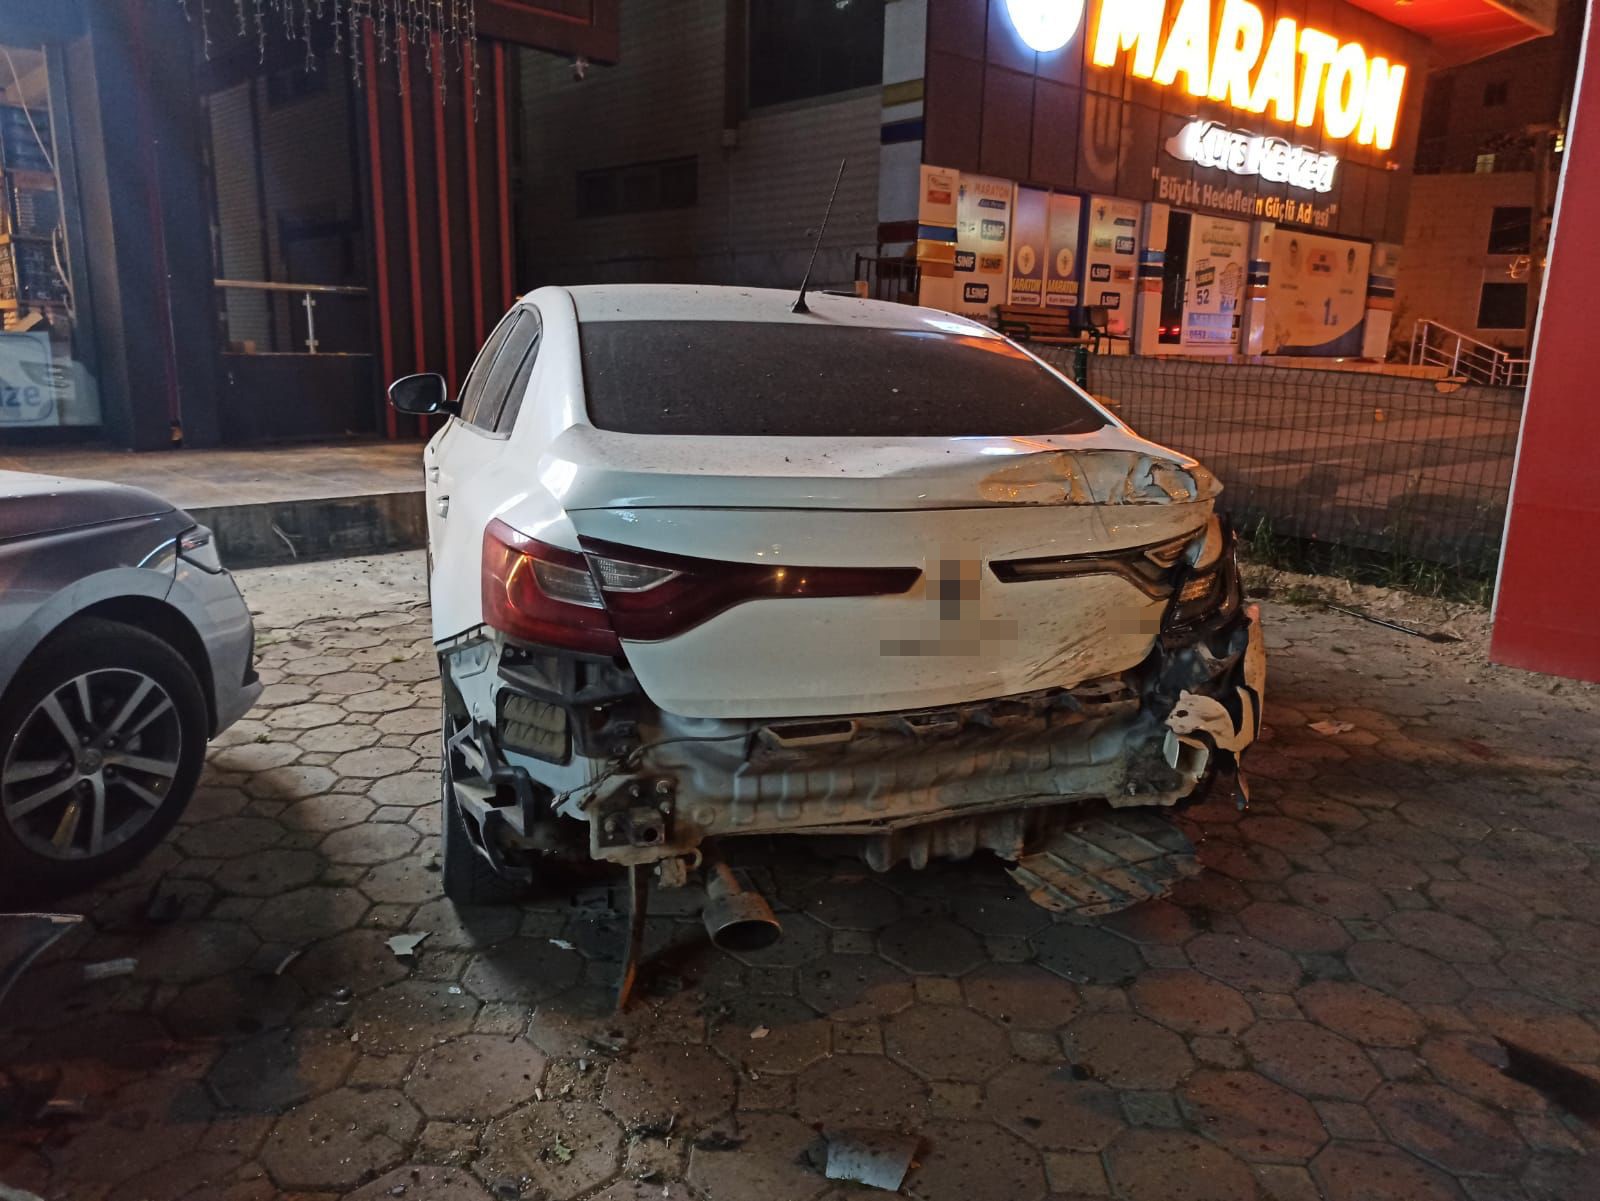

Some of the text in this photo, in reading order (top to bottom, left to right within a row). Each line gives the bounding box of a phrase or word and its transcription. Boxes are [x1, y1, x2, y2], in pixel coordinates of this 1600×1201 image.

[1092, 0, 1407, 150] MARATON
[1202, 184, 1263, 215] Hedeflerin
[1265, 197, 1295, 223] Güçlü
[1197, 289, 1209, 305] 52
